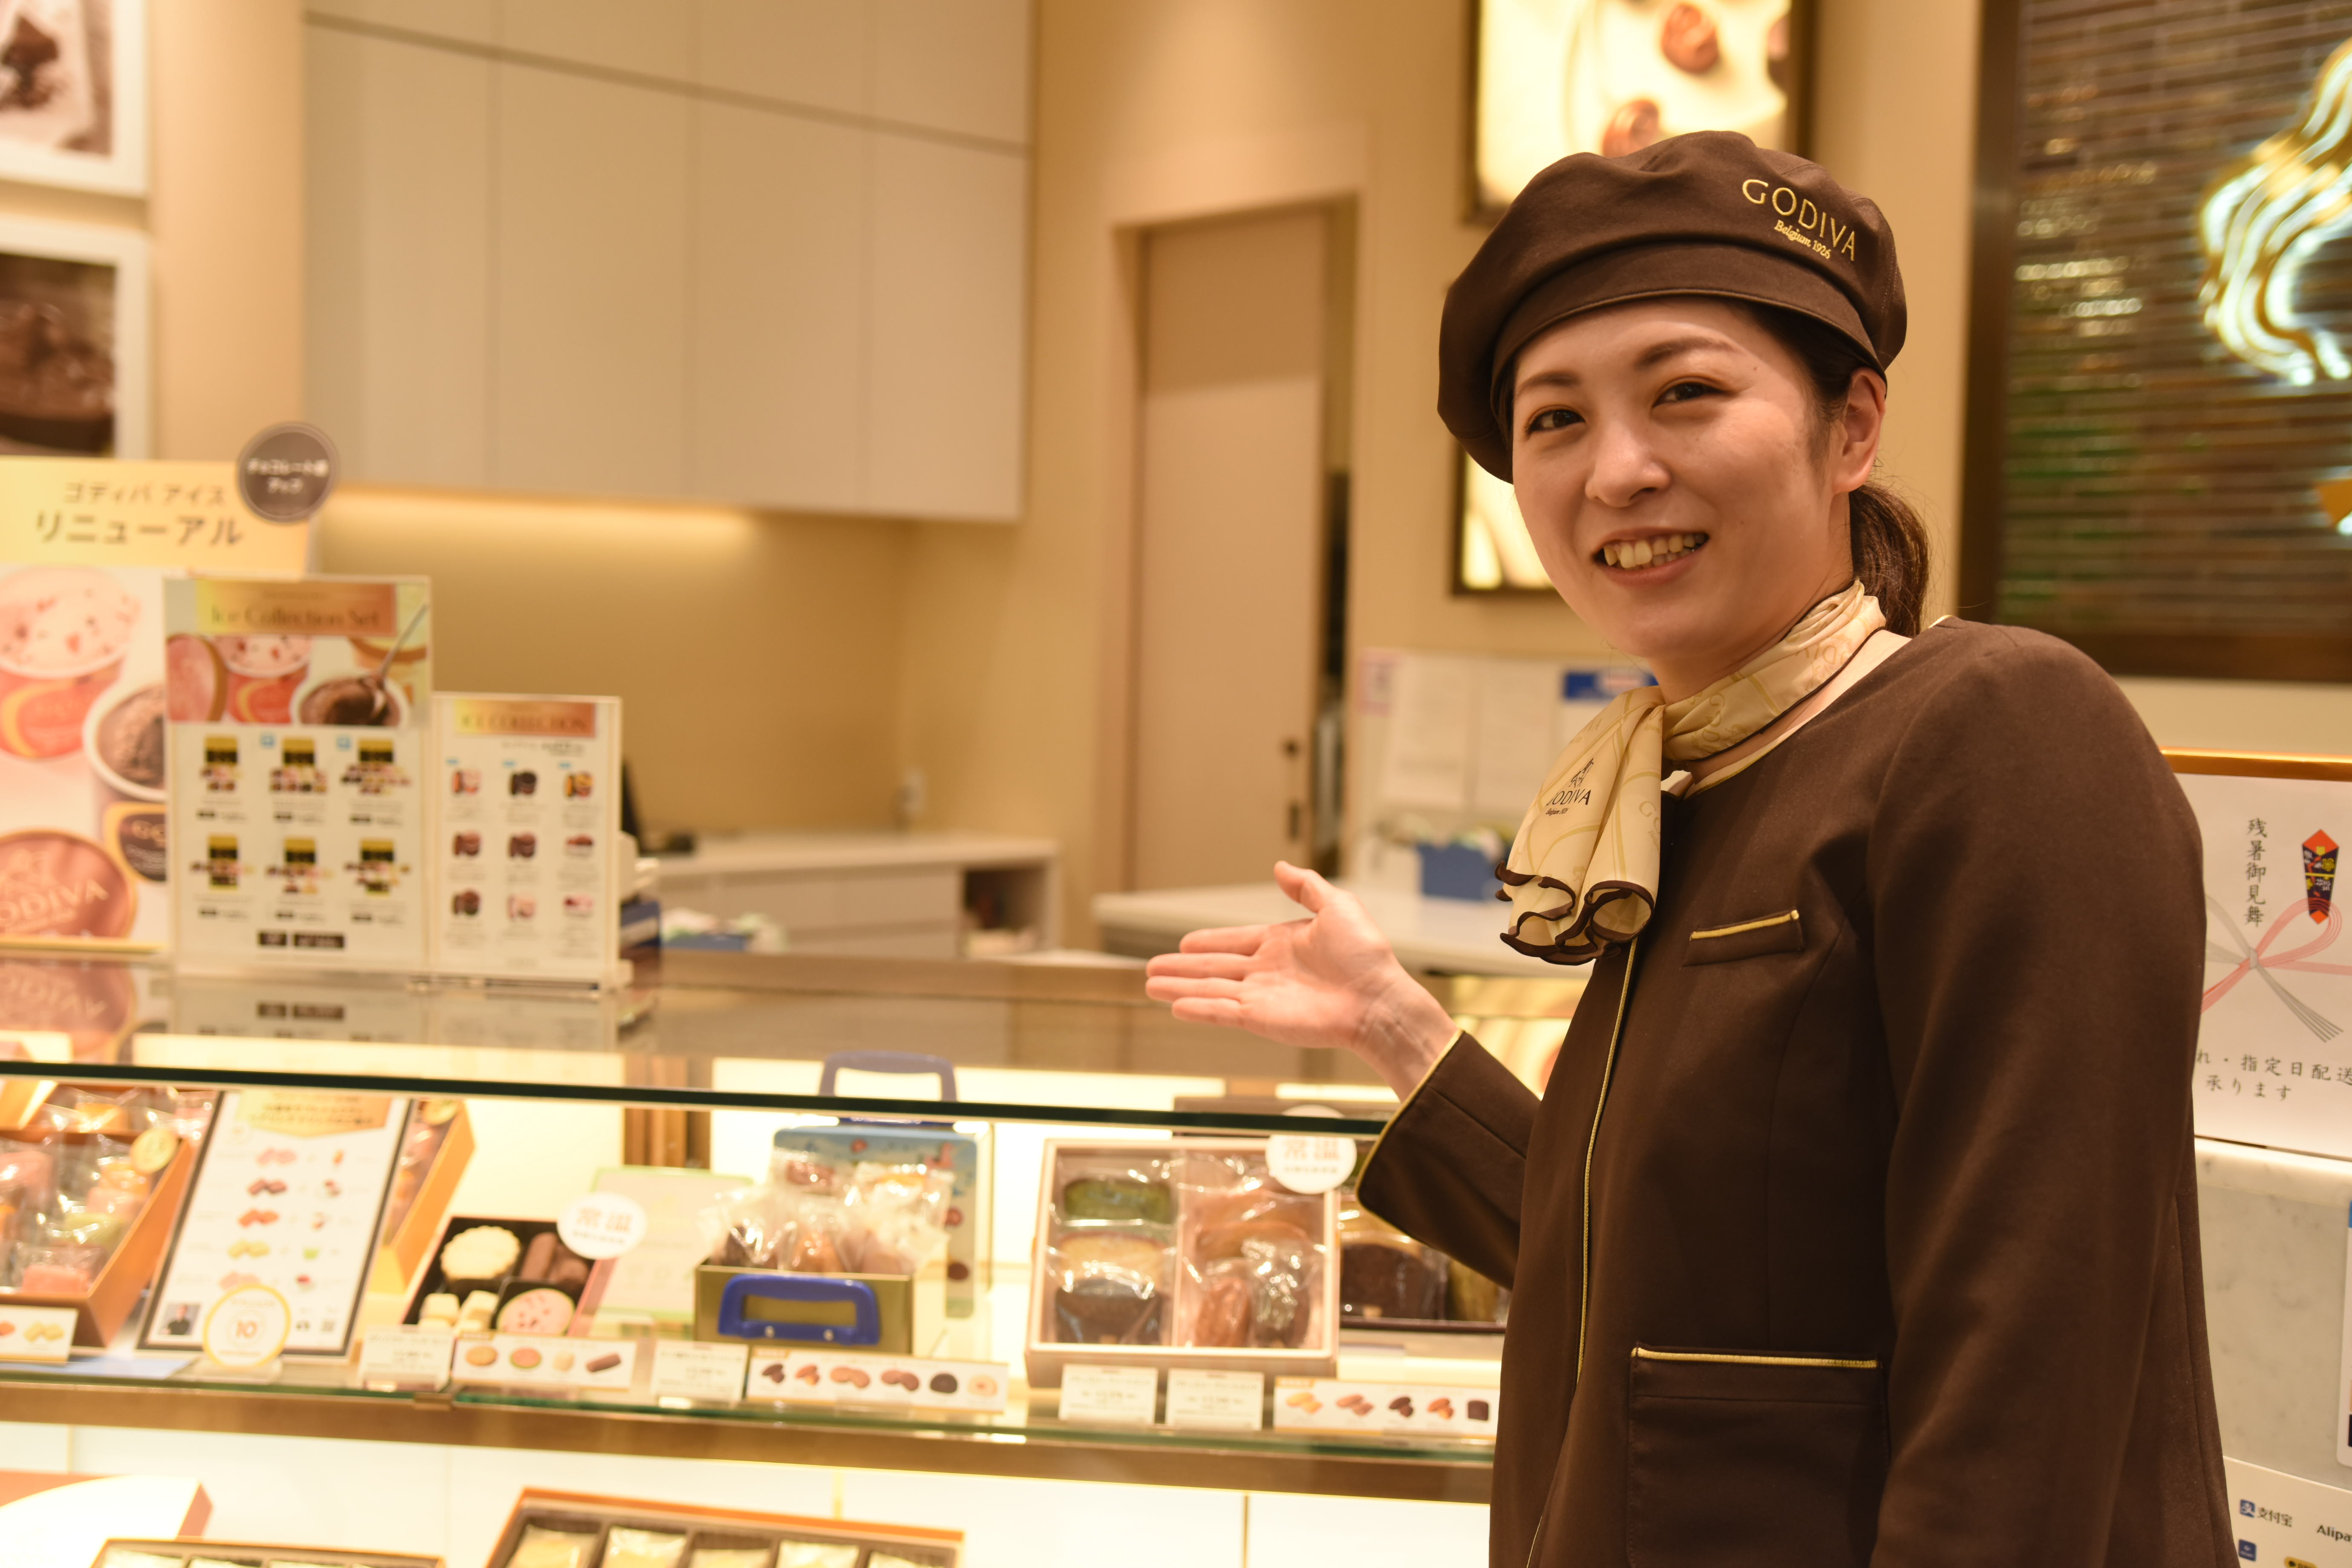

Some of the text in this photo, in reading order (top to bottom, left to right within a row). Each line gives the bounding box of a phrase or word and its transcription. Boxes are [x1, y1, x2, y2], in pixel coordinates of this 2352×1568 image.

[1742, 179, 1854, 261] GODIVA
[1774, 220, 1831, 259] Belgium 1926
[65, 481, 225, 506] ゴディバ アイス
[36, 511, 242, 547] リニューアル
[2245, 817, 2268, 928] 残暑御見舞
[2207, 1074, 2291, 1101] 承ります
[235, 1322, 258, 1338] 10
[2258, 1507, 2292, 1528] 支付宝
